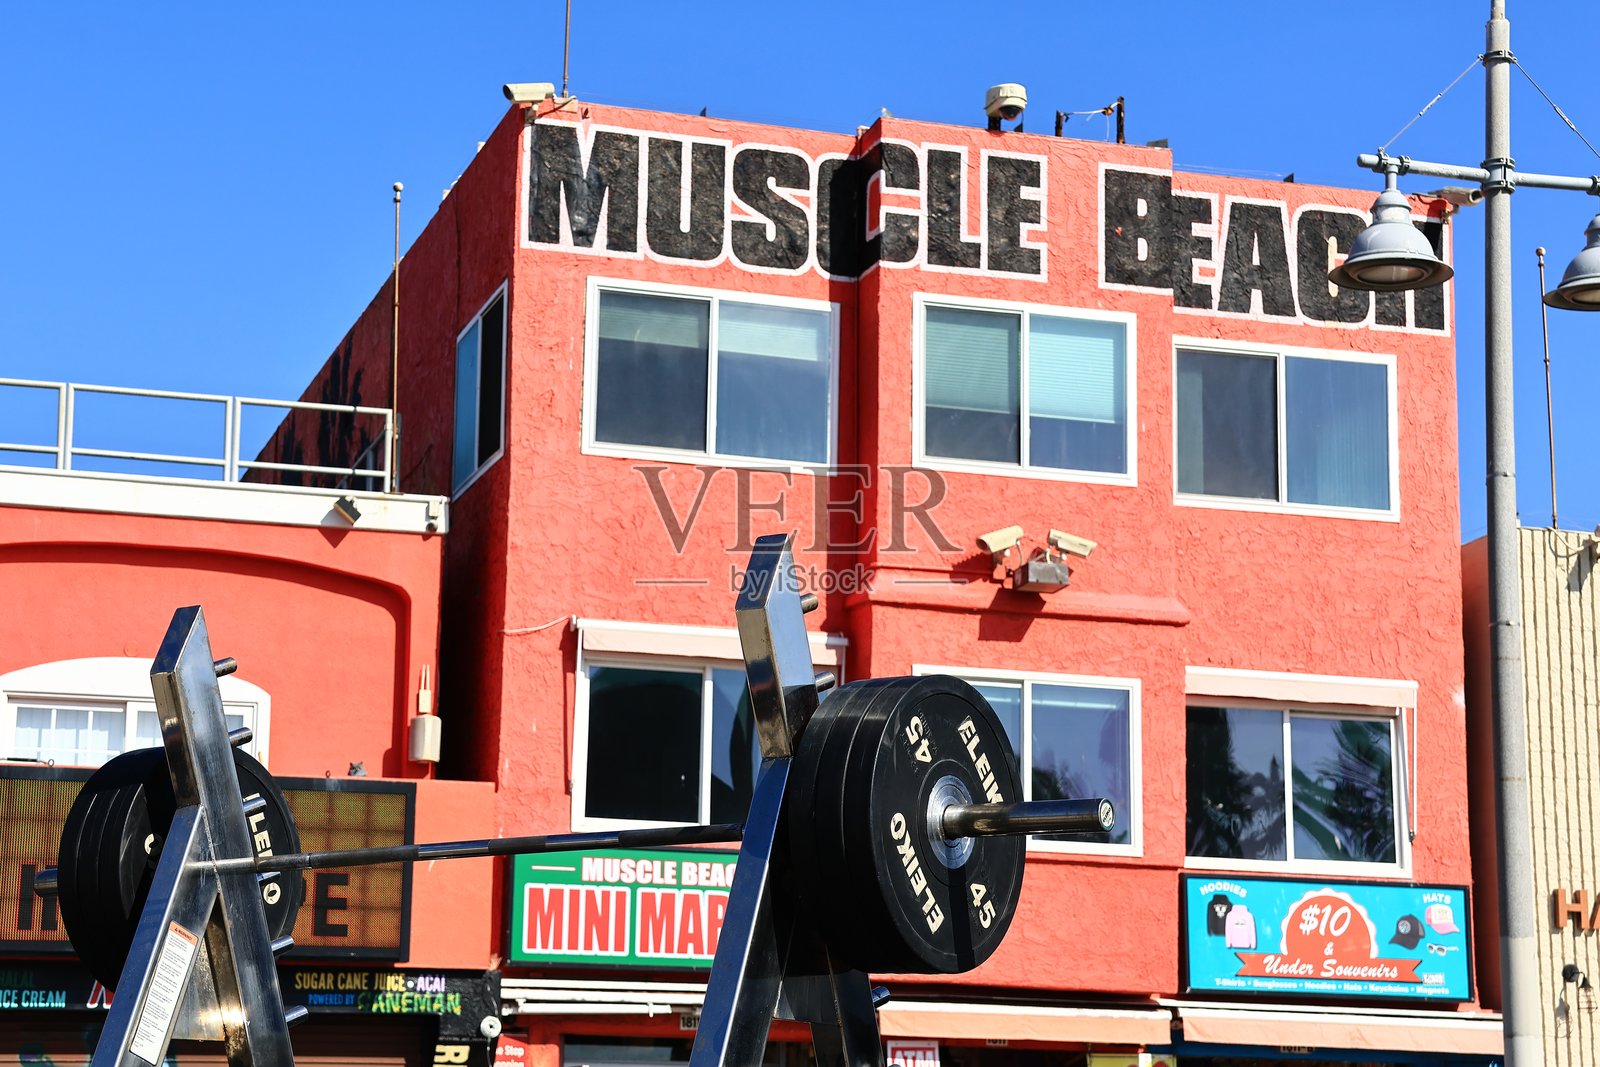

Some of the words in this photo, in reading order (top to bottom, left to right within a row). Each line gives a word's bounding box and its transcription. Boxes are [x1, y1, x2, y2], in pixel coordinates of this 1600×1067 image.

[521, 118, 1048, 282] MUSCLE
[957, 715, 1004, 804] ELEIK
[581, 856, 677, 885] MUSCLE
[890, 812, 945, 935] ELEIKO
[1199, 881, 1248, 898] HOODIES
[1422, 892, 1452, 905] HATS
[970, 882, 997, 930] 45
[522, 883, 631, 957] MINI
[1299, 904, 1352, 937] $10
[1324, 941, 1334, 956] &
[1263, 954, 1314, 976] Under
[1320, 959, 1398, 978] Souvenirs
[295, 972, 334, 990] SUGAR
[337, 972, 369, 990] CANE
[374, 973, 406, 992] JUICE
[21, 989, 67, 1008] CREAM
[308, 993, 344, 1006] POWERED
[345, 993, 355, 1006] BY
[504, 1044, 525, 1058] Stop
